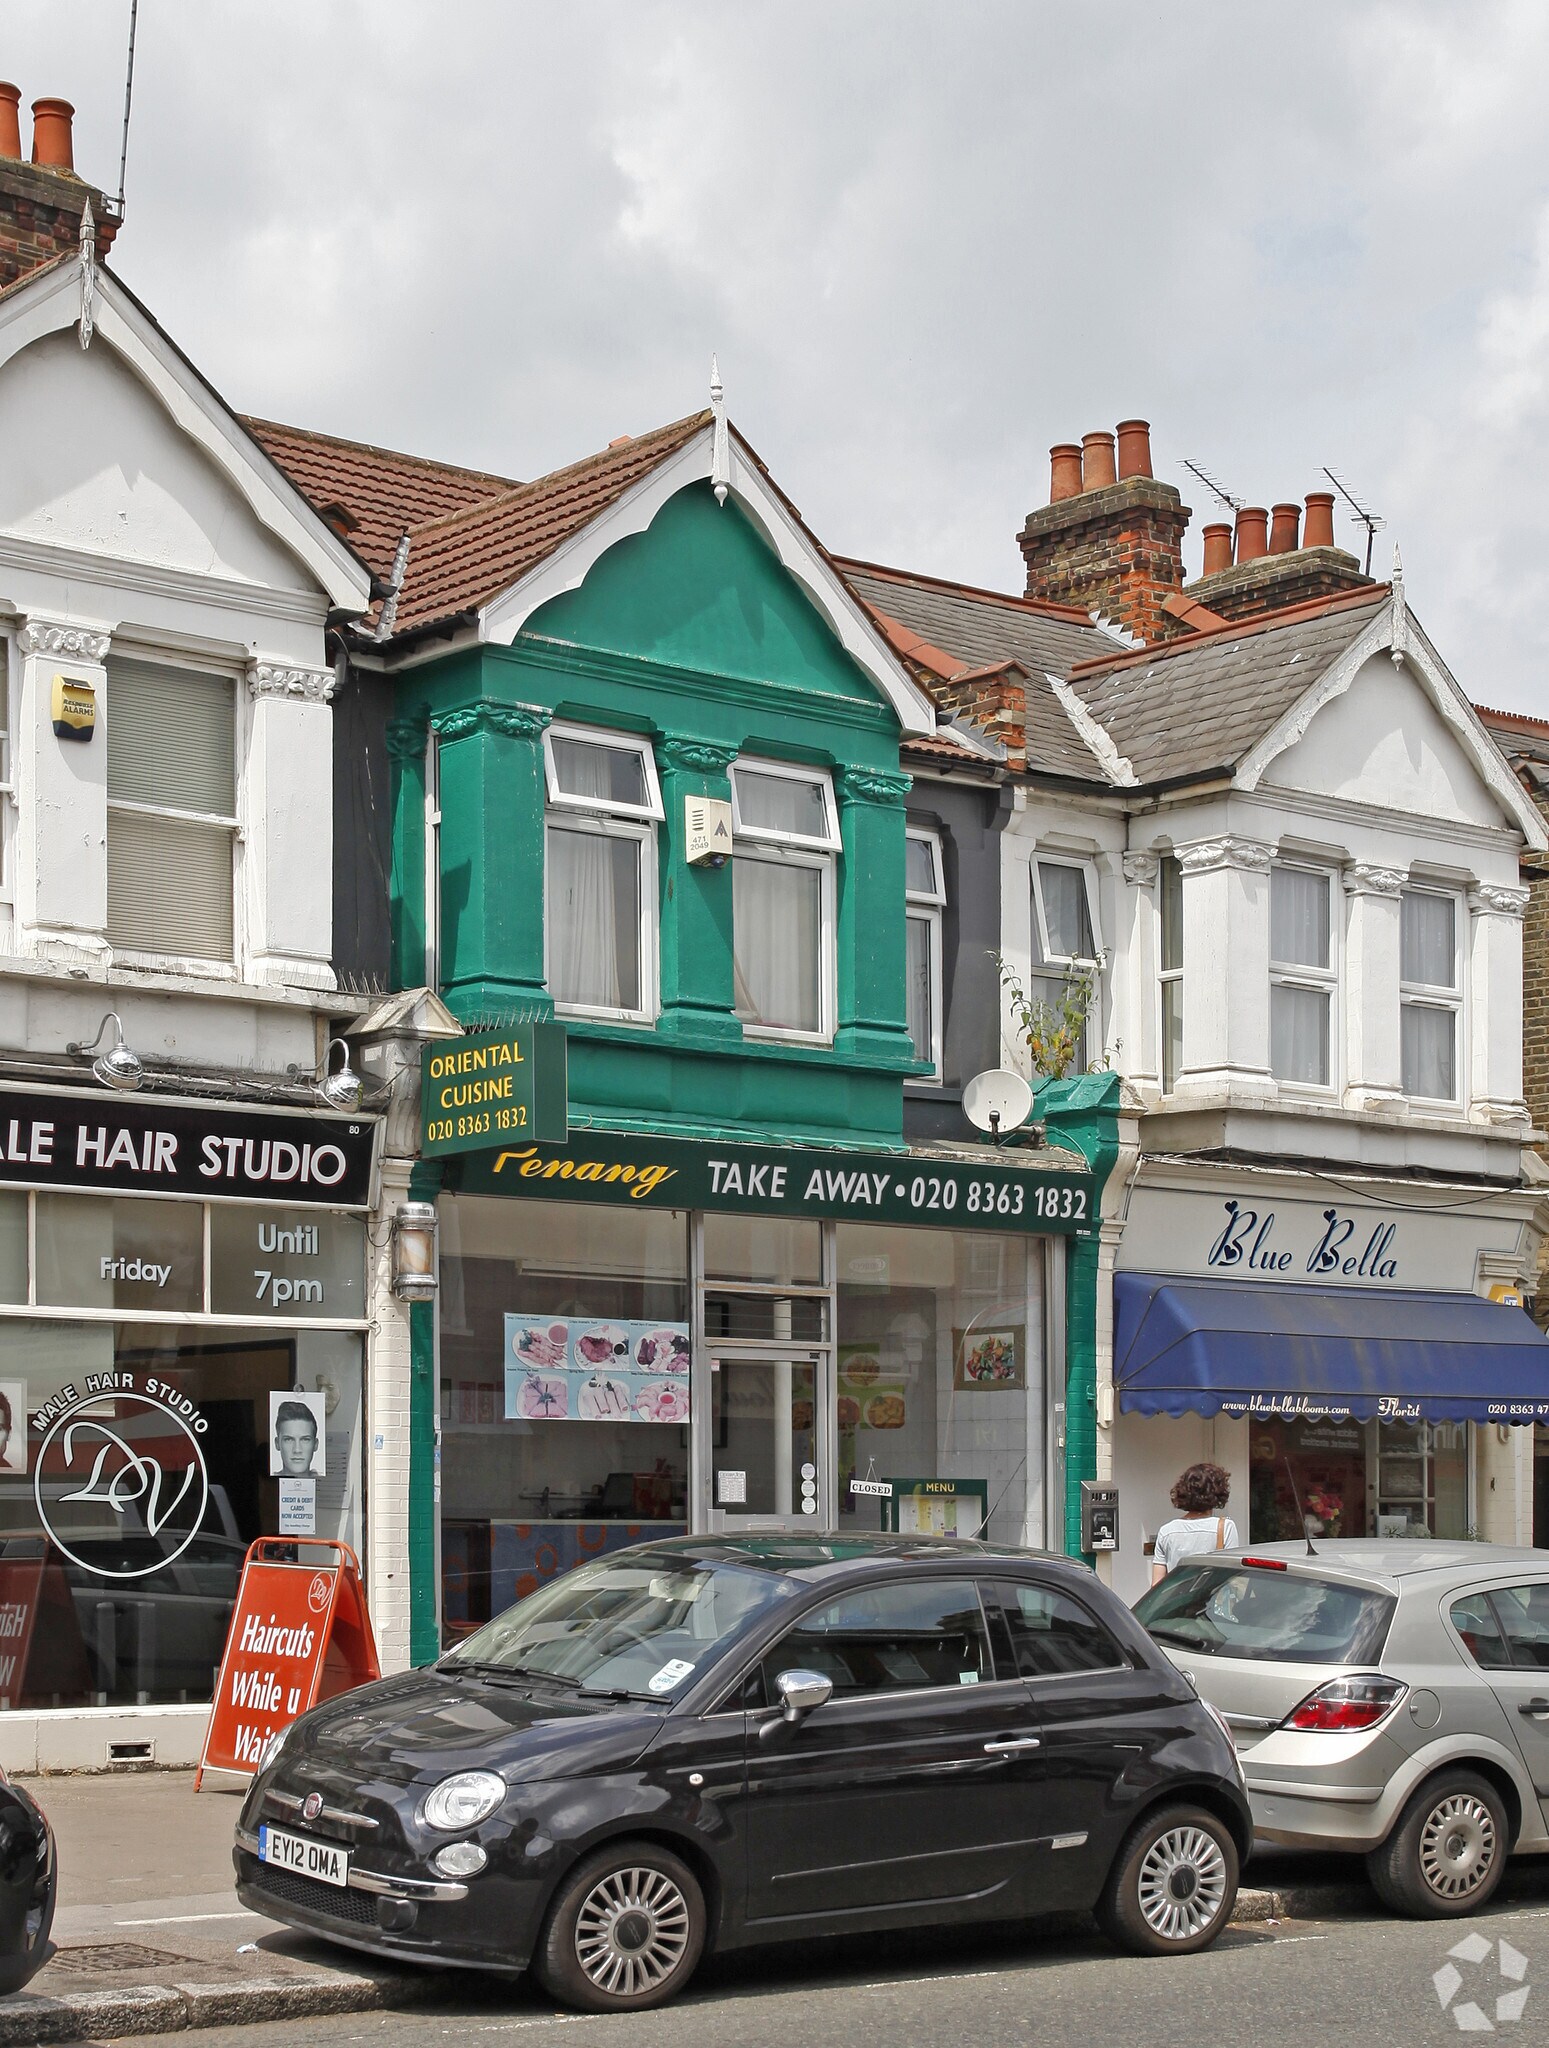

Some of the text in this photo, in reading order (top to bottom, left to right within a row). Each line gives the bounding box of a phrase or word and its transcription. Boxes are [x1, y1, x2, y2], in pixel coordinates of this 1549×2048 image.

[63, 706, 94, 716] ALARMS
[690, 841, 709, 851] 2049
[430, 1041, 524, 1078] ORIENTAL
[440, 1075, 514, 1109] CUISINE
[348, 1125, 360, 1134] 80
[427, 1105, 527, 1142] 020 8363 1832
[76, 1125, 178, 1173] HAIR
[198, 1135, 347, 1185] STUDIO
[707, 1160, 788, 1198] TAKE
[803, 1168, 891, 1205] AWAY
[910, 1176, 958, 1209] 020
[967, 1182, 1024, 1214] 8363
[1034, 1186, 1087, 1220] 1832
[257, 1223, 319, 1256] Until
[1207, 1200, 1398, 1279] Blue Bella
[100, 1256, 172, 1287] Friday
[254, 1270, 324, 1307] 7pm
[32, 1371, 209, 1434] MALE HAIR STUDIO
[1222, 1394, 1351, 1415] www.bluebellablooms.com
[1377, 1397, 1420, 1417] Florist
[1488, 1404, 1507, 1414] 020
[1510, 1405, 1534, 1415] 8363
[851, 1483, 891, 1496] CLOSED
[925, 1482, 956, 1492] MENU
[239, 1613, 315, 1659] Haircuts
[231, 1669, 283, 1713] While
[287, 1687, 301, 1715] u
[272, 1833, 339, 1878] EY12 OMA
